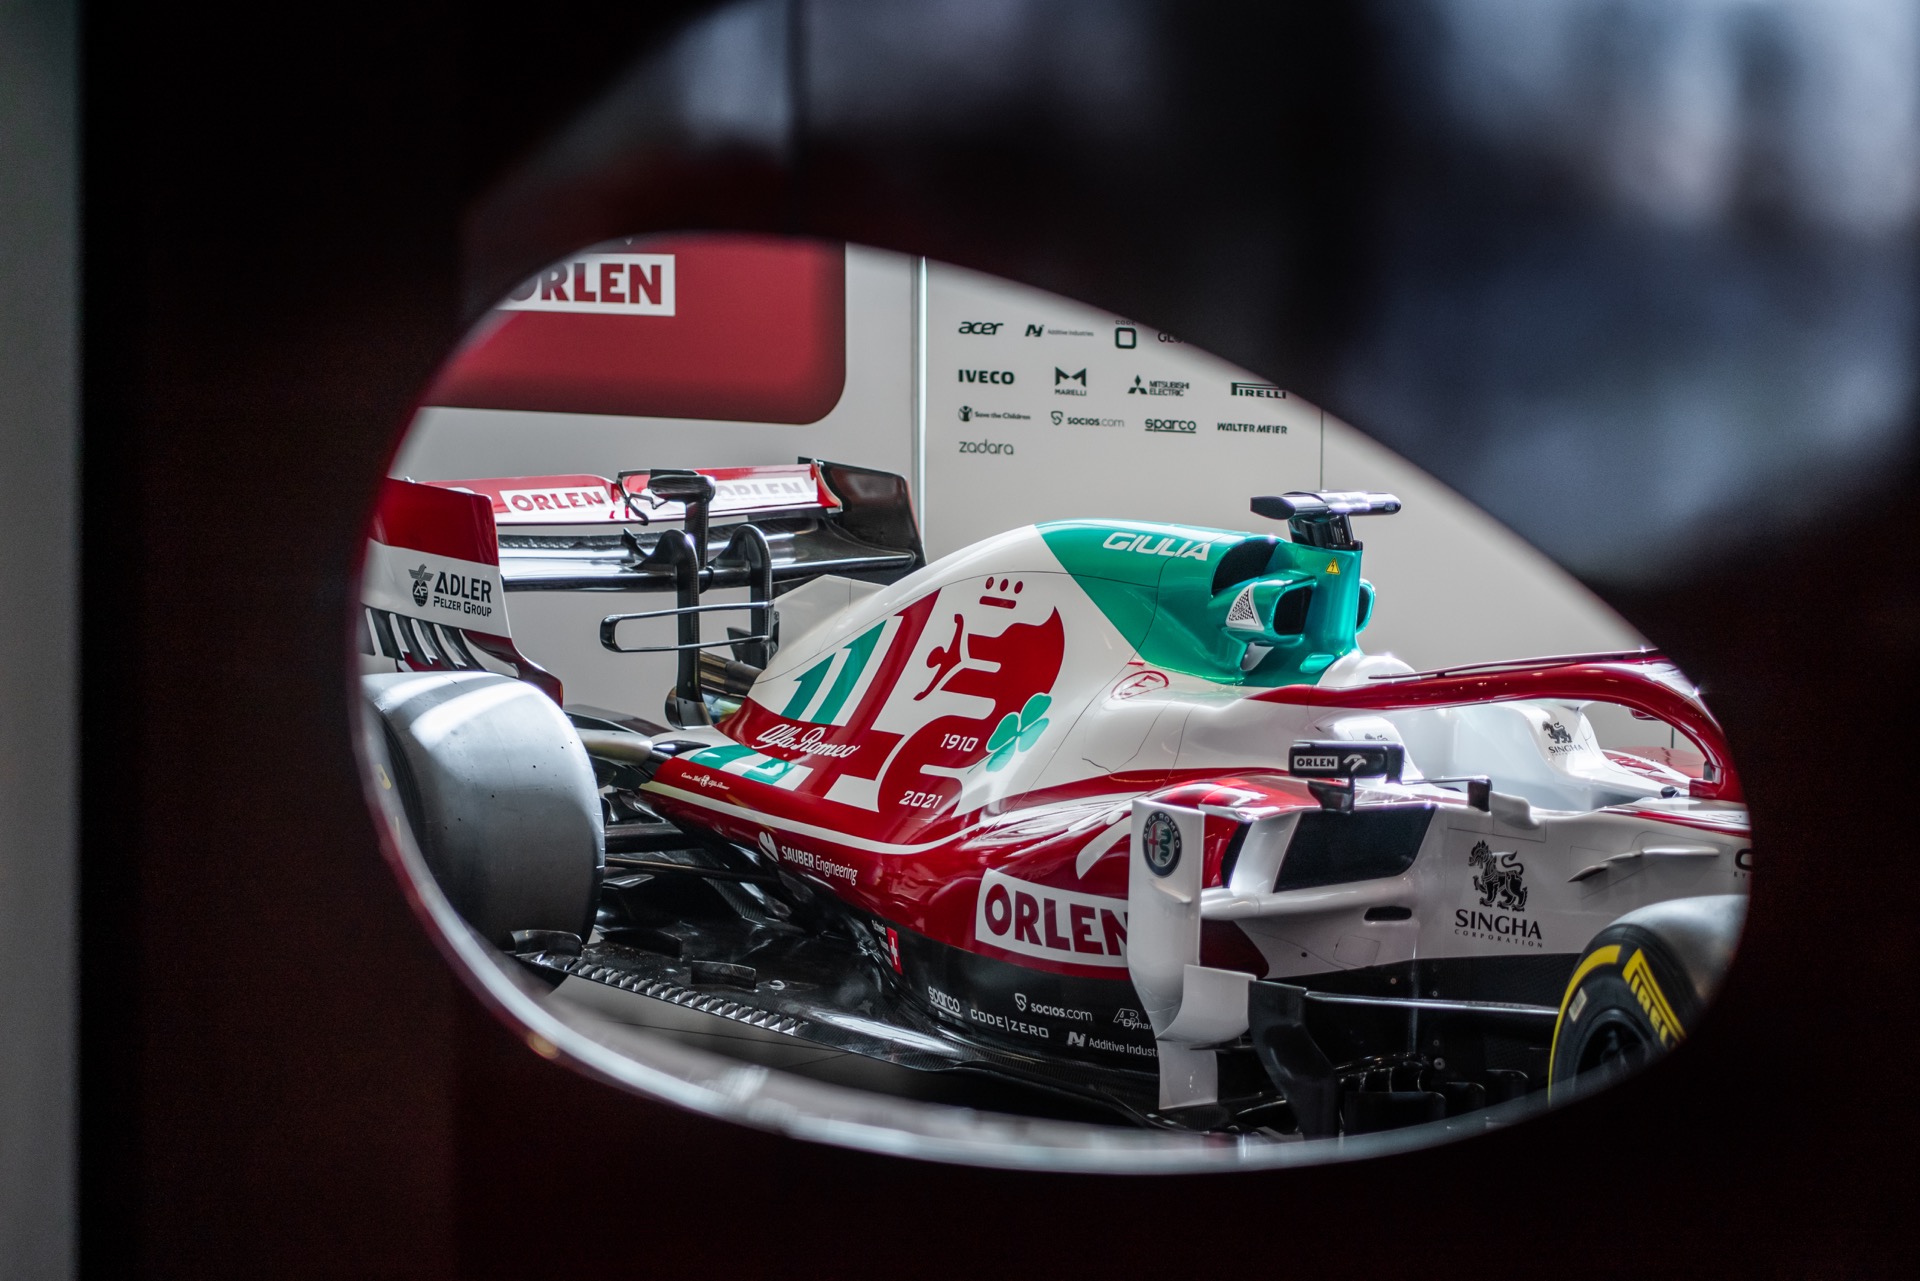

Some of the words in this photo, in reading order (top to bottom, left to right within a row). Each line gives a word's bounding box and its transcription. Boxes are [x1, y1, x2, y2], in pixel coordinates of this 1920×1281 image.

[958, 321, 1004, 336] acer
[958, 369, 1015, 385] IVECO
[1150, 380, 1190, 390] MITSUBISHI
[1055, 388, 1087, 397] MARELLI
[1150, 388, 1184, 397] ELECTRIC
[1230, 382, 1287, 400] PIRELLI
[1145, 418, 1197, 434] sparco
[1217, 422, 1255, 433] WALTER
[1256, 424, 1288, 435] MEIER
[958, 438, 1015, 456] zadara
[510, 491, 606, 512] ORLEN
[1102, 531, 1212, 562] GIULIA
[434, 571, 493, 604] ADLER
[433, 596, 462, 612] PELZER
[463, 601, 493, 618] GROUP
[751, 723, 803, 750] Alfa
[800, 726, 861, 758] Romeo
[940, 733, 979, 752] 1910
[1296, 757, 1335, 768] ORLEN
[898, 790, 943, 809] 2021
[781, 845, 815, 869] SAUBER
[815, 855, 858, 886] Engineering
[984, 883, 1128, 957] ORLEN
[1455, 908, 1543, 940] SINGHA
[1454, 928, 1543, 948] CORPORATION
[1089, 1037, 1125, 1053] Additive
